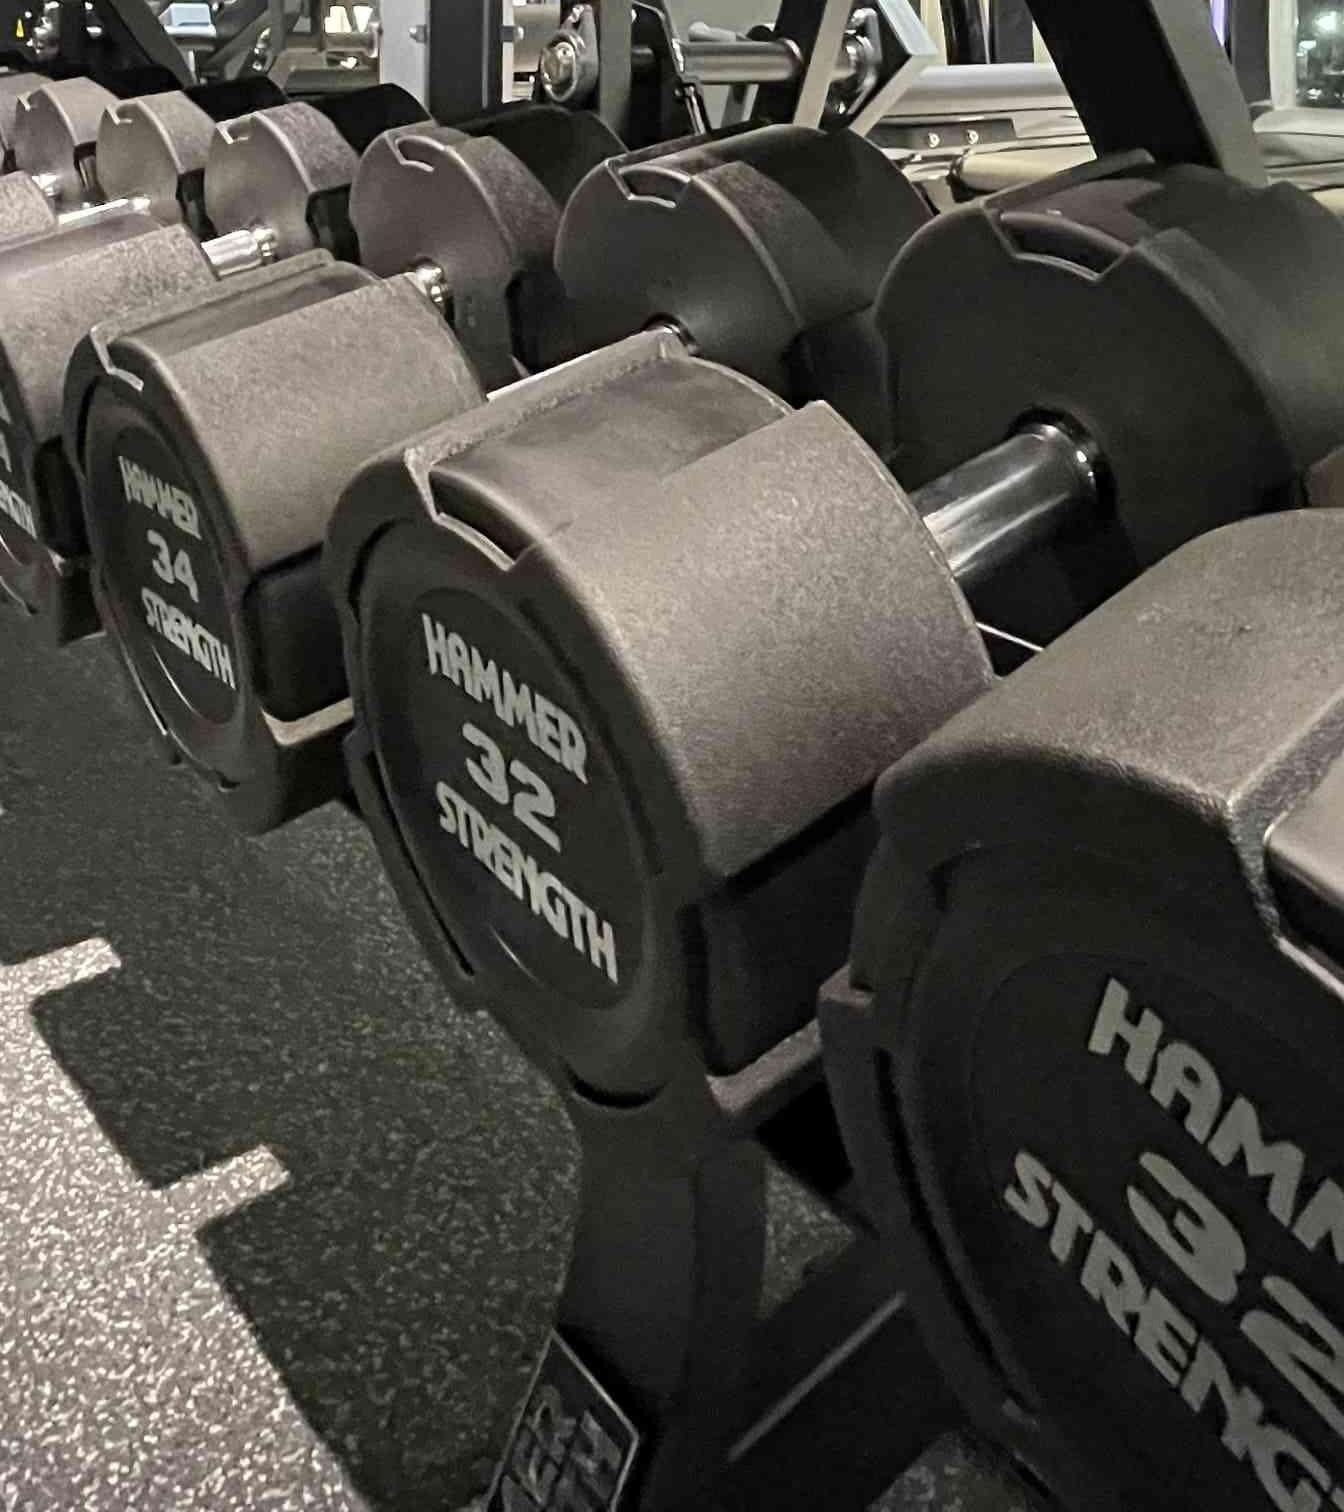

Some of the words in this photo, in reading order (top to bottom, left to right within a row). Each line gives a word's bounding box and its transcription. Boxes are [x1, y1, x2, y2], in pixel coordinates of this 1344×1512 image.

[146, 528, 200, 604] 34
[141, 587, 237, 691] STRENGTH
[421, 612, 589, 785] HAMMER
[461, 721, 562, 854] 32
[435, 780, 620, 985] STRENGTH
